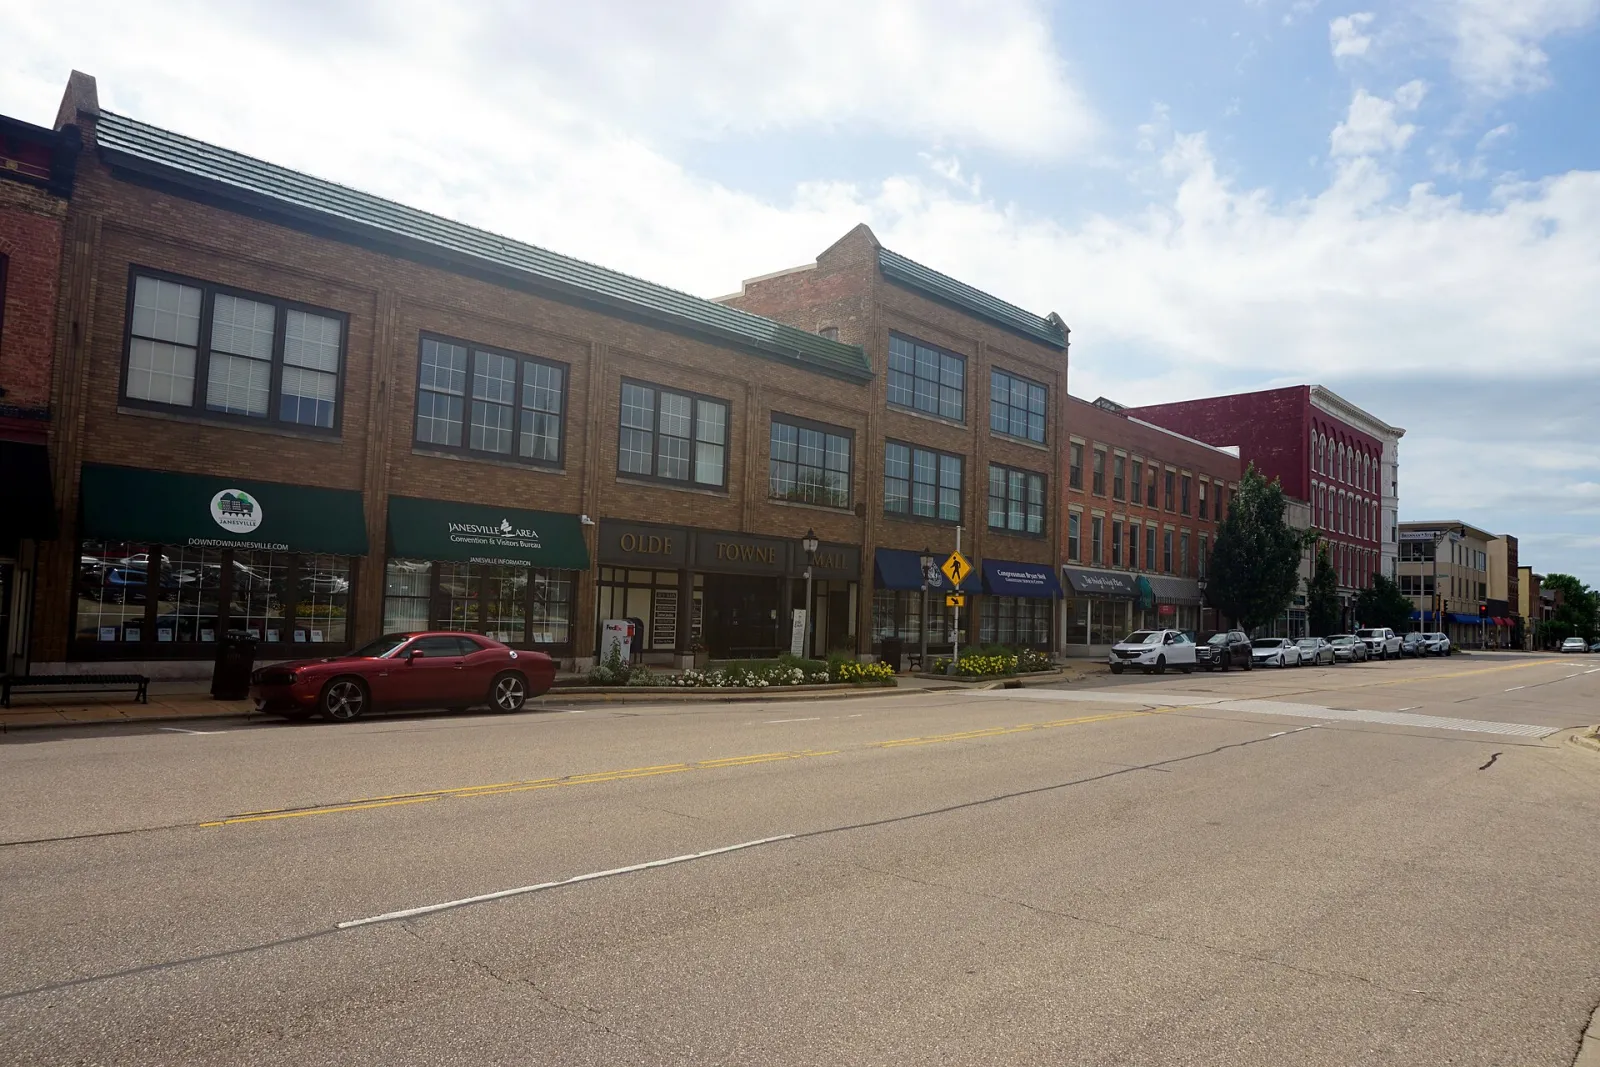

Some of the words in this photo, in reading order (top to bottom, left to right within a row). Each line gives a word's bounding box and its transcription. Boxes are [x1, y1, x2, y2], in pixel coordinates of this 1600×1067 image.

[219, 519, 257, 527] JANESVILLE
[448, 522, 501, 535] JANESVILLE
[515, 528, 539, 539] AREA
[188, 537, 289, 551] DOWNTOWNJANESVILLE.COM
[450, 534, 489, 545] Convention
[489, 537, 496, 545] &
[496, 538, 520, 547] Visitors
[520, 540, 542, 549] Bureau
[620, 532, 673, 555] OLDE
[716, 542, 776, 565] TOWNE
[811, 552, 848, 570] MALL
[469, 556, 498, 565] JANESVILLE
[498, 557, 531, 566] INFORMATION
[606, 624, 623, 632] FedEx
